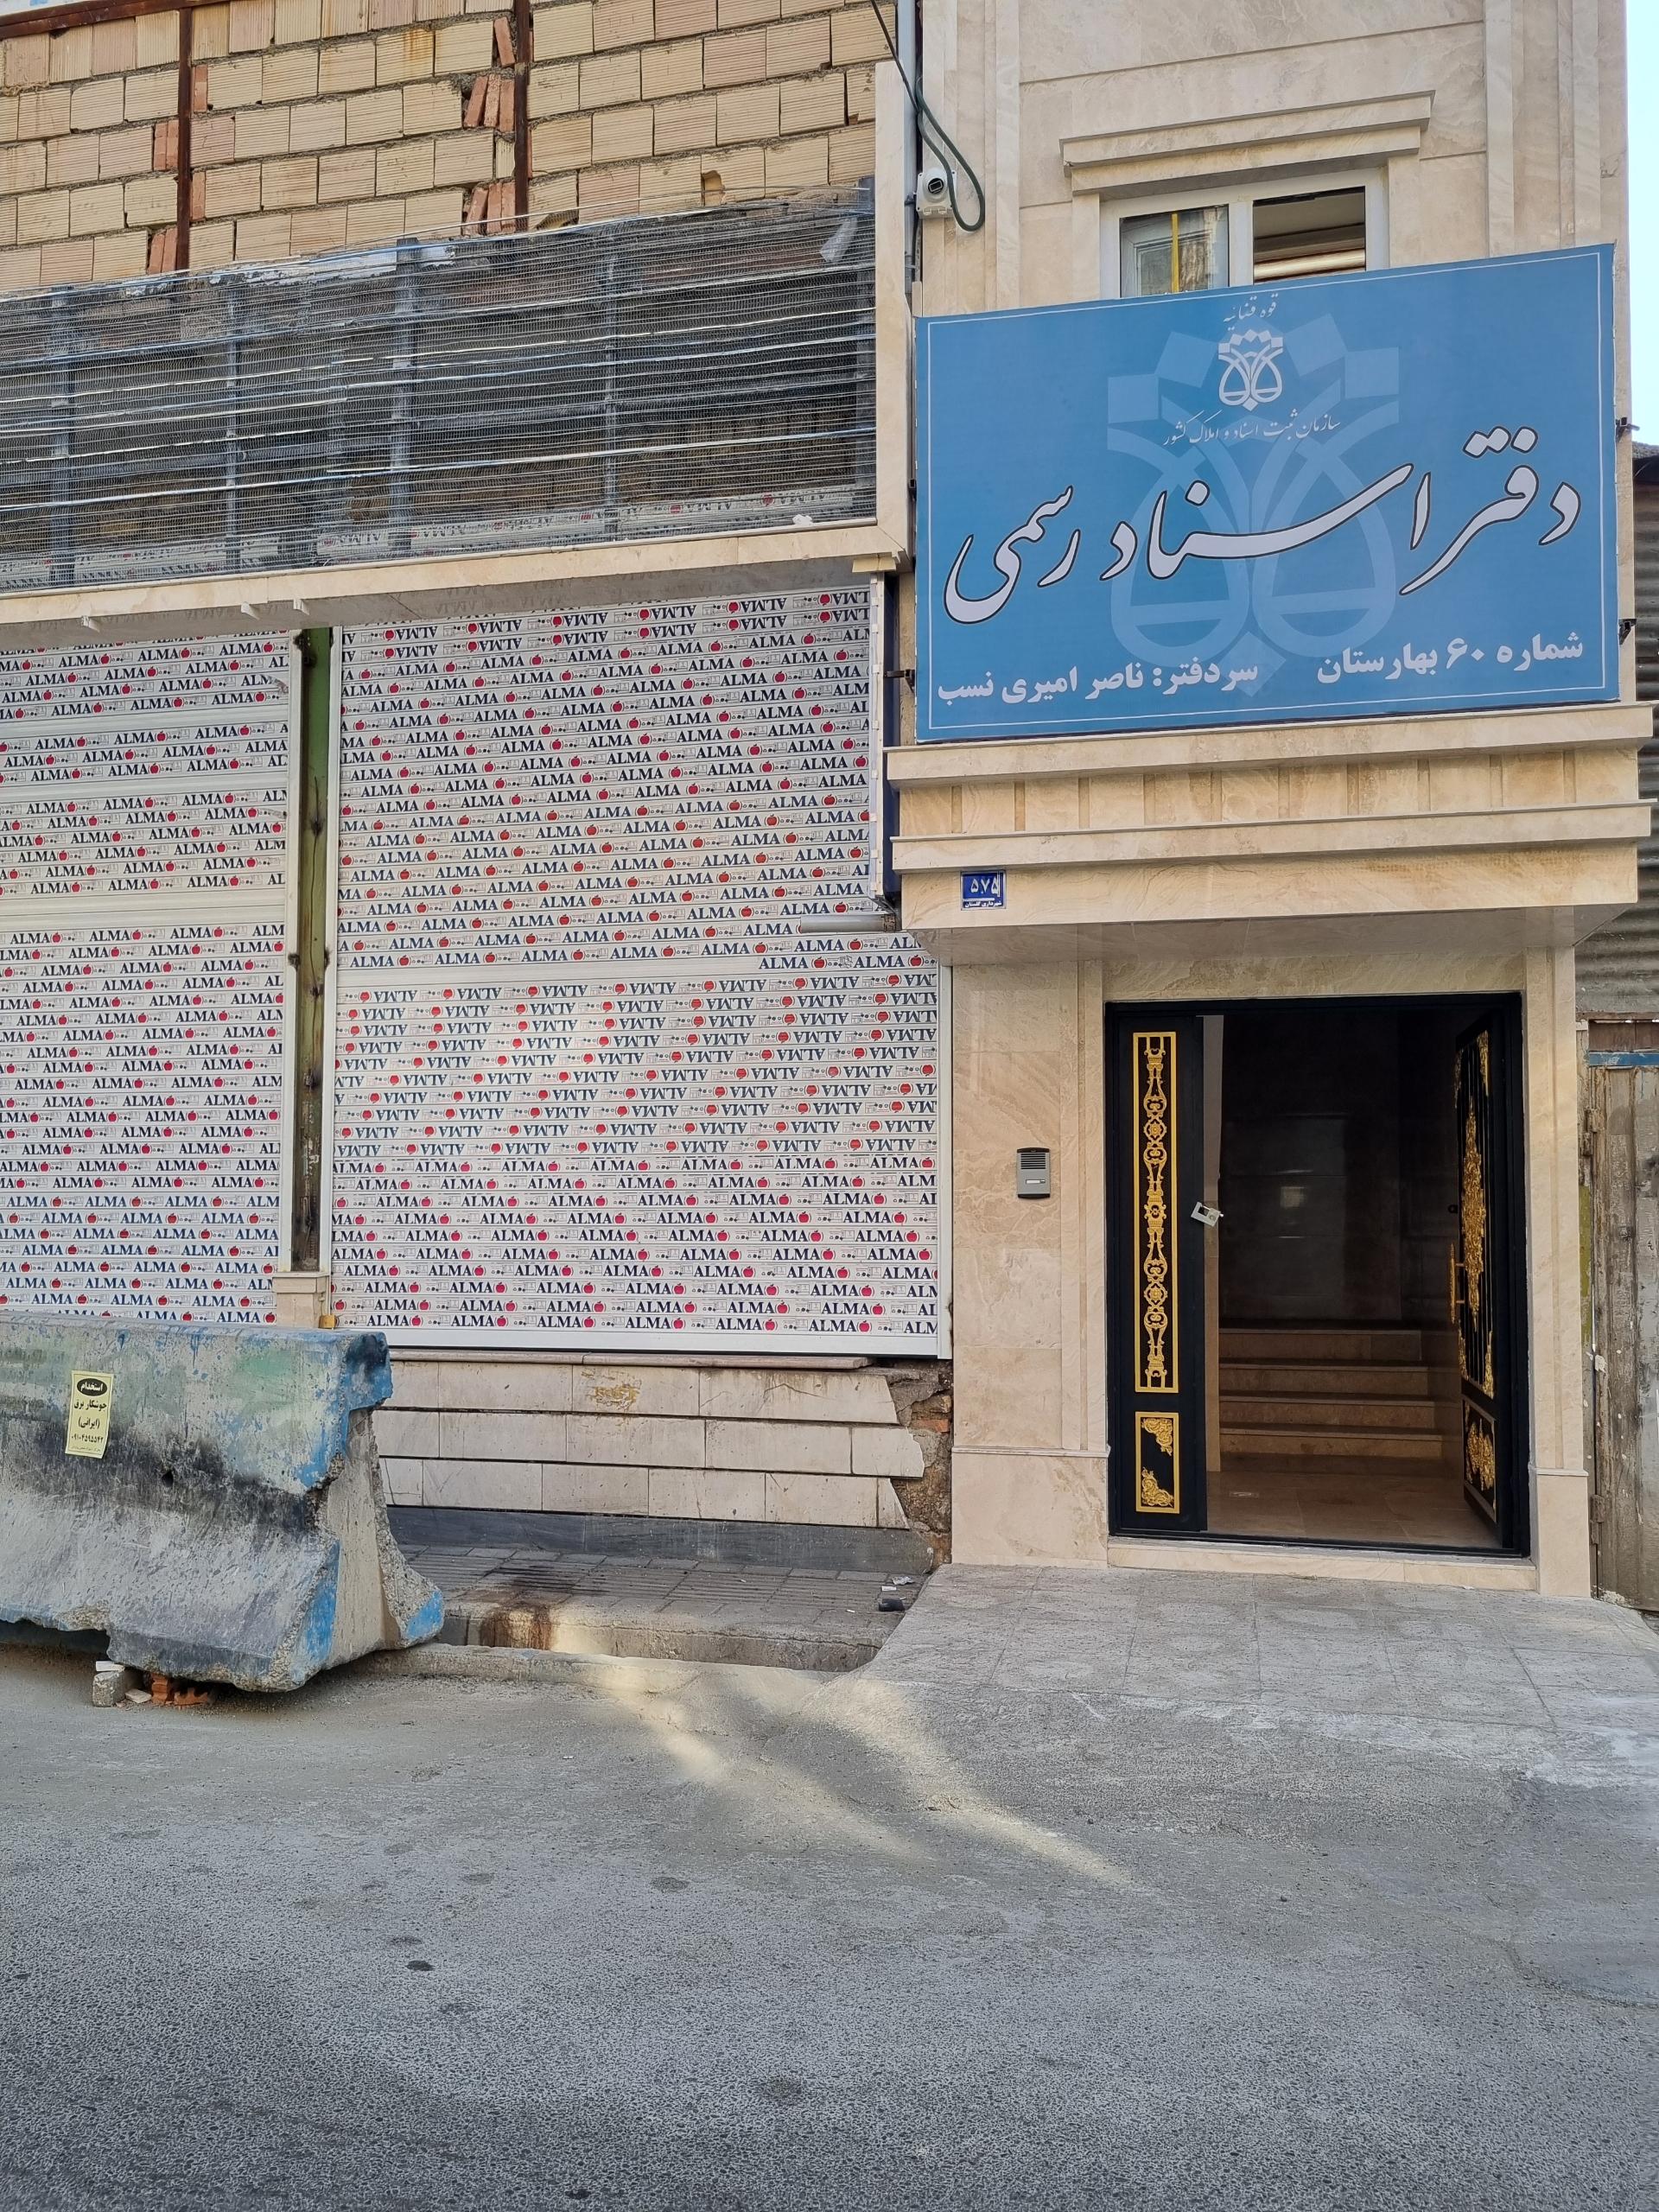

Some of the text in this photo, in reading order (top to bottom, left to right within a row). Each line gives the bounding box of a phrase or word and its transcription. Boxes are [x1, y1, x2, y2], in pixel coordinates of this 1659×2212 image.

[1260, 293, 1279, 318] قوه
[1163, 410, 1205, 446] کشور
[1189, 410, 1223, 443] املاک
[1234, 423, 1259, 438] اسناد
[1264, 409, 1298, 441] ثبت
[1295, 414, 1341, 439] سازمان
[944, 426, 1581, 625] دفتر اسناد رسمی
[394, 614, 787, 659] ALMA ALMA ALMA ALMA ALMA
[58, 642, 264, 668] ALMA ALMA ALMA
[1317, 631, 1584, 683] شماره ۶۰ بهارستان
[25, 660, 230, 686] ALMA ALMA ALMA
[1001, 665, 1077, 704] امیری
[1084, 662, 1144, 700] ناصر
[369, 665, 861, 713] ALMA ALMA ALMA ALMA ALMA ALMA
[938, 671, 995, 706] نسب
[51, 692, 257, 716] ALMA ALMA ALMA
[404, 705, 804, 744] ALMA ALMA ALMA ALMA ALMA
[3, 740, 288, 768] ALMA ALMA ALMA ALMA
[360, 756, 849, 798] ALMA ALMA ALMA ALMA ALMA ALMA
[26, 793, 223, 815] ALMA ALMA ALMA
[366, 810, 855, 847] ALMA ALMA ALMA ALMA ALMA ALMA
[17, 847, 135, 863] ALMA ALMA
[350, 847, 845, 882] ALMA ALMA ALMA ALMA ALMA ALMA
[10, 926, 212, 944] ALMA ALMA ALMA
[389, 923, 793, 950] ALMA ALMA ALMA ALMA ALMA
[41, 959, 243, 976] ALMA ALMA ALMA
[69, 993, 273, 1008] ALMA ALMA ALMA
[27, 1044, 228, 1058] ALMA ALMA ALMA
[344, 1046, 919, 1071] ALMA ALMA ALMA ALMA ALMA ALMA ALMA
[42, 1094, 245, 1108] ALMA ALMA ALMA
[384, 1084, 871, 1103] ALMA ALMA ALMA ALMA ALMA ALMA
[355, 1120, 935, 1139] ALMA ALMA ALMA ALMA ALMA ALMA ALMA
[22, 1142, 219, 1155] ALMA ALMA ALMA
[53, 1177, 253, 1188] ALMA ALMA ALMA
[394, 1211, 893, 1224] ALMA ALMA ALMA ALMA ALMA ALMA
[73, 1228, 279, 1240] ALMA ALMA ALMA
[416, 1248, 917, 1261] ALMA ALMA ALMA ALMA ALMA ALMA
[54, 1261, 258, 1274] ALMA ALMA ALMA
[374, 1299, 873, 1315] ALMA ALMA ALMA ALMA ALMA ALMA
[80, 1382, 104, 1392] استخدام
[73, 1399, 107, 1412] جوشکار برق
[78, 1417, 100, 1429] (ایرانی)
